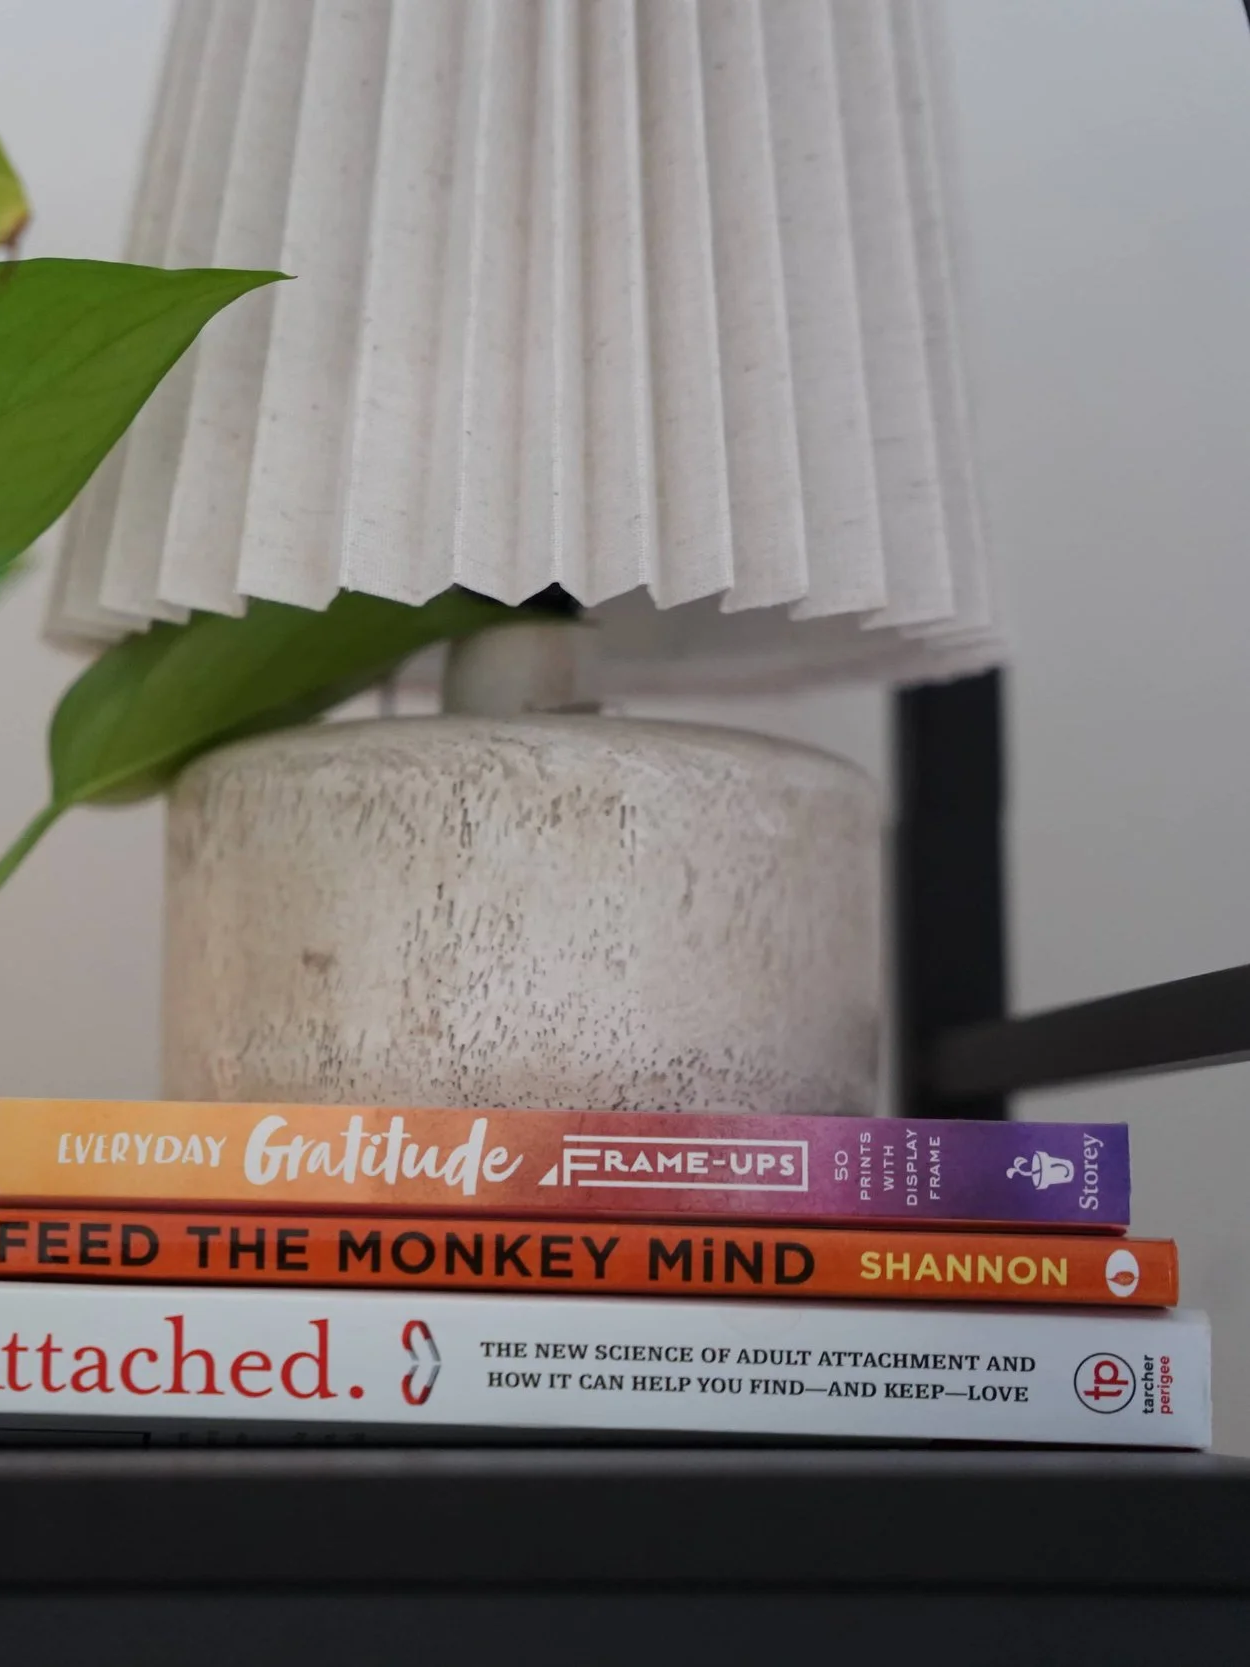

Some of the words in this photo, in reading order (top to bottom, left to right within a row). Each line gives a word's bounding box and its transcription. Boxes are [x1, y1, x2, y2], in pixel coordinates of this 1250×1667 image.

[57, 1132, 227, 1168] EVERYDAY
[243, 1114, 524, 1195] Gratitude
[563, 1148, 796, 1187] FRAME-UPS
[834, 1150, 849, 1181] 50
[860, 1131, 872, 1201] PRINTS
[883, 1145, 895, 1191] WITH
[906, 1128, 918, 1206] DISPLAY
[929, 1136, 941, 1200] FRAME
[1079, 1132, 1104, 1210] Storey
[187, 1225, 311, 1273] THE
[337, 1229, 621, 1280] MONKEY
[859, 1250, 1068, 1287] SHANNON
[480, 1341, 528, 1359] THE
[534, 1343, 589, 1361] NEW
[594, 1344, 694, 1364] SCIENCE
[700, 1347, 731, 1364] OF
[736, 1349, 812, 1367] ADULT
[817, 1350, 980, 1371] ATTACHMENT
[986, 1355, 1036, 1373] AND
[487, 1371, 542, 1389] HOW
[548, 1373, 572, 1390] IT
[579, 1374, 624, 1391] CAN
[631, 1375, 692, 1393] HELP
[697, 1377, 743, 1395] YOU
[1141, 1354, 1154, 1415] tarcher
[1157, 1355, 1173, 1415] perigee
